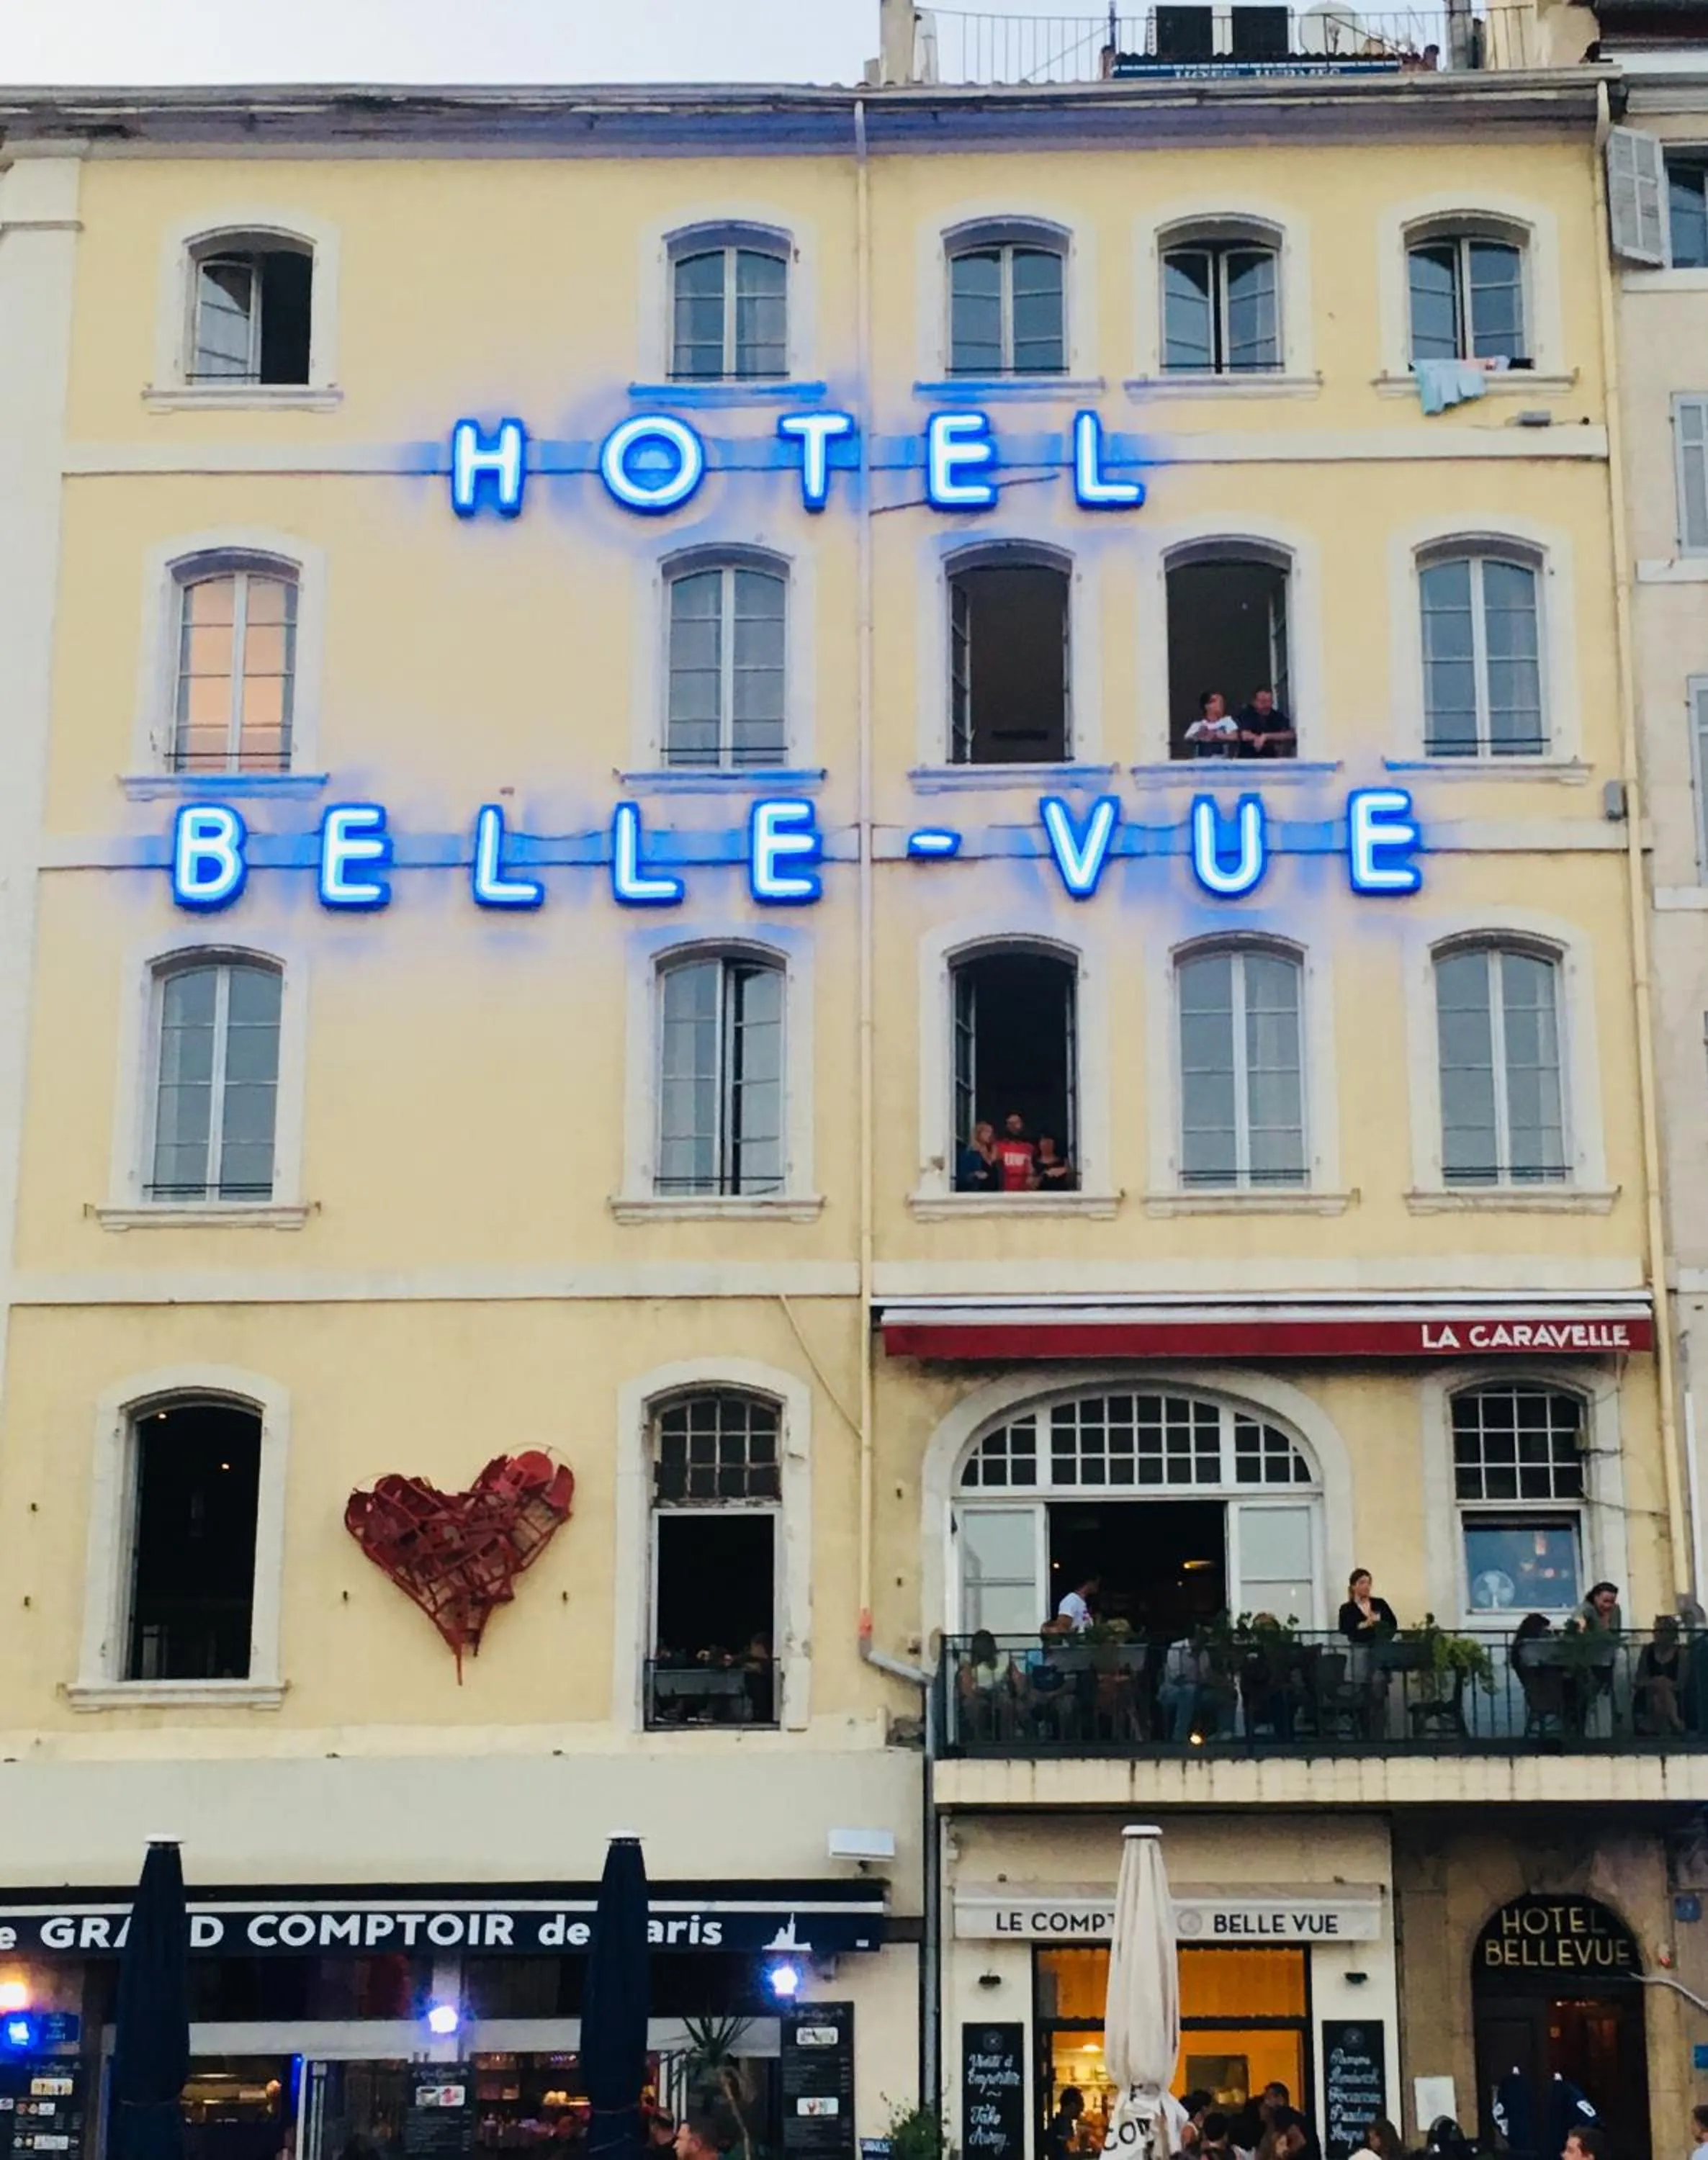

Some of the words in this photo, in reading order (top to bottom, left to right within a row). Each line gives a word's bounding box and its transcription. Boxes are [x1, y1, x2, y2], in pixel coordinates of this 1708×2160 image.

[452, 409, 1146, 514] HOTEL
[1421, 1324, 1460, 1349] LA
[1469, 1324, 1631, 1348] CARAVELLE
[0, 1926, 17, 1950] e
[40, 1916, 225, 1949] GRD
[247, 1913, 514, 1947] COMPTOIR
[538, 1913, 591, 1946] de
[647, 1914, 723, 1945] aris
[996, 1912, 1023, 1932] LE
[1213, 1913, 1286, 1934] BELLE
[1292, 1913, 1339, 1934] VUE
[1501, 1907, 1608, 1935] HOTEL
[1485, 1938, 1632, 1966] BELLEVUE
